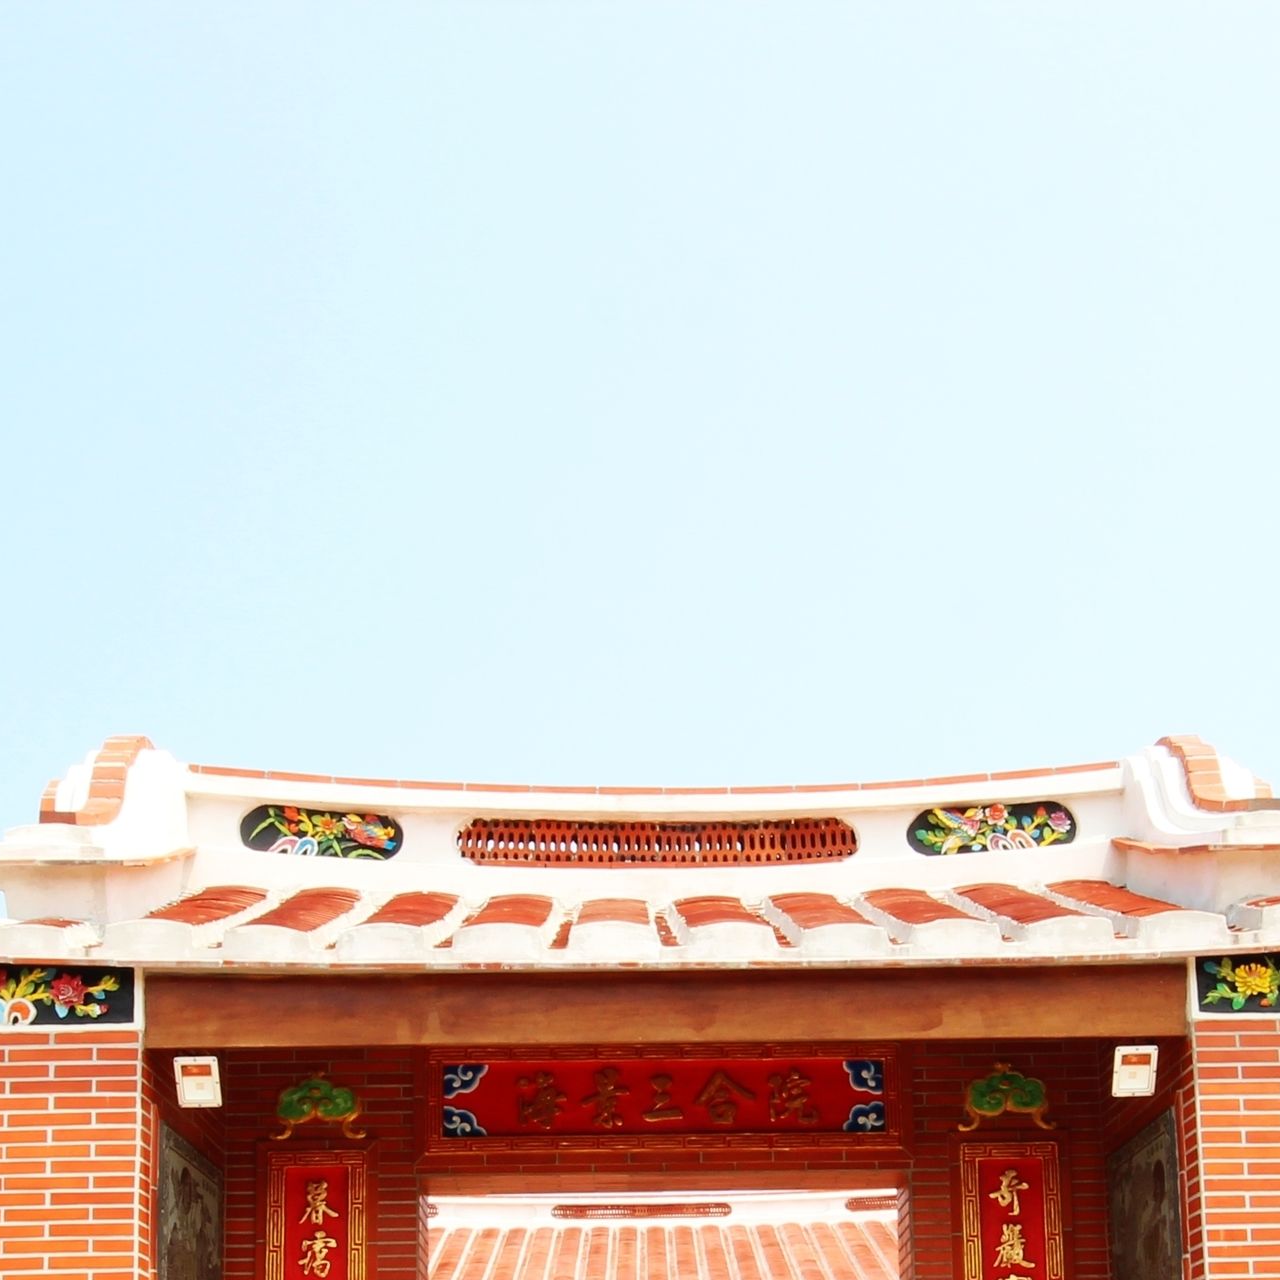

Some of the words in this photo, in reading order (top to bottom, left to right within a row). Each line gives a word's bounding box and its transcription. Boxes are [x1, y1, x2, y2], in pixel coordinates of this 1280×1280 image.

[516, 1067, 819, 1129] 海景三合院
